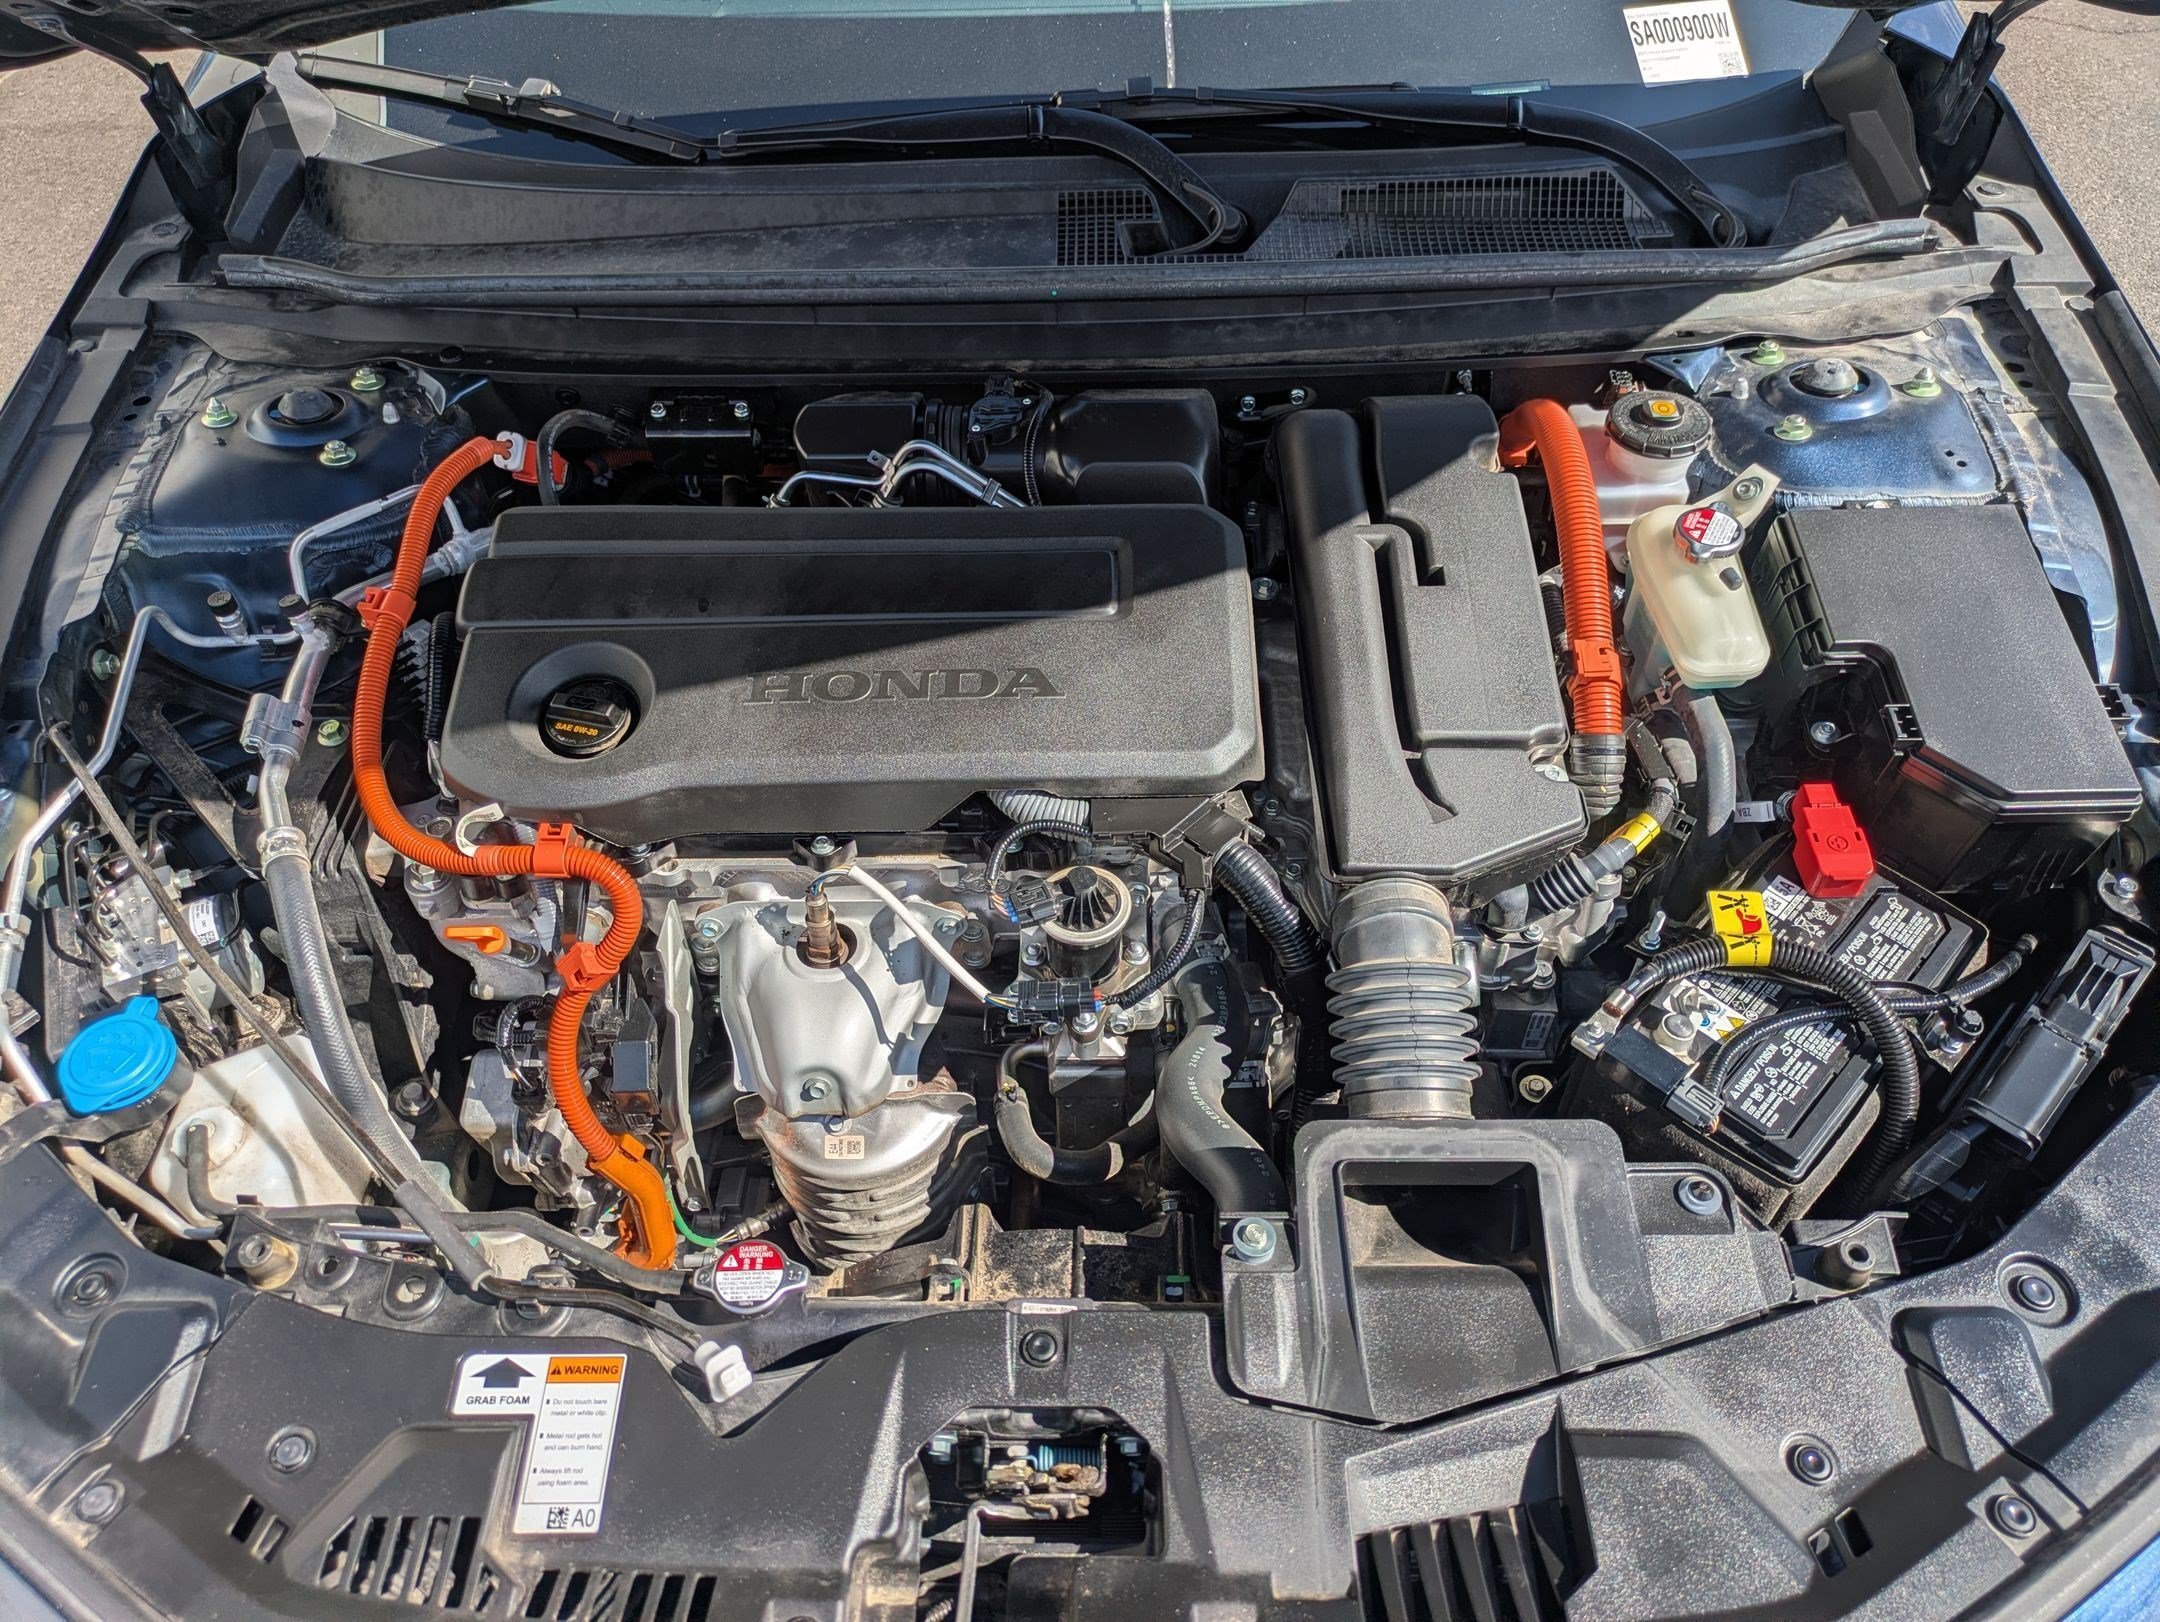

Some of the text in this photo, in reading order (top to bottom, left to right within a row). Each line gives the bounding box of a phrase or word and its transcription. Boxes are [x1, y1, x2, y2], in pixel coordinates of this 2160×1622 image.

[1630, 12, 1729, 46] SA000900W
[743, 667, 1066, 705] HONDA
[555, 722, 599, 736] SAE 0W-20
[564, 1365, 619, 1375] WARNING
[466, 1396, 530, 1405] GRAB FOAM
[539, 1467, 562, 1475] Always
[571, 1508, 596, 1527] A0
